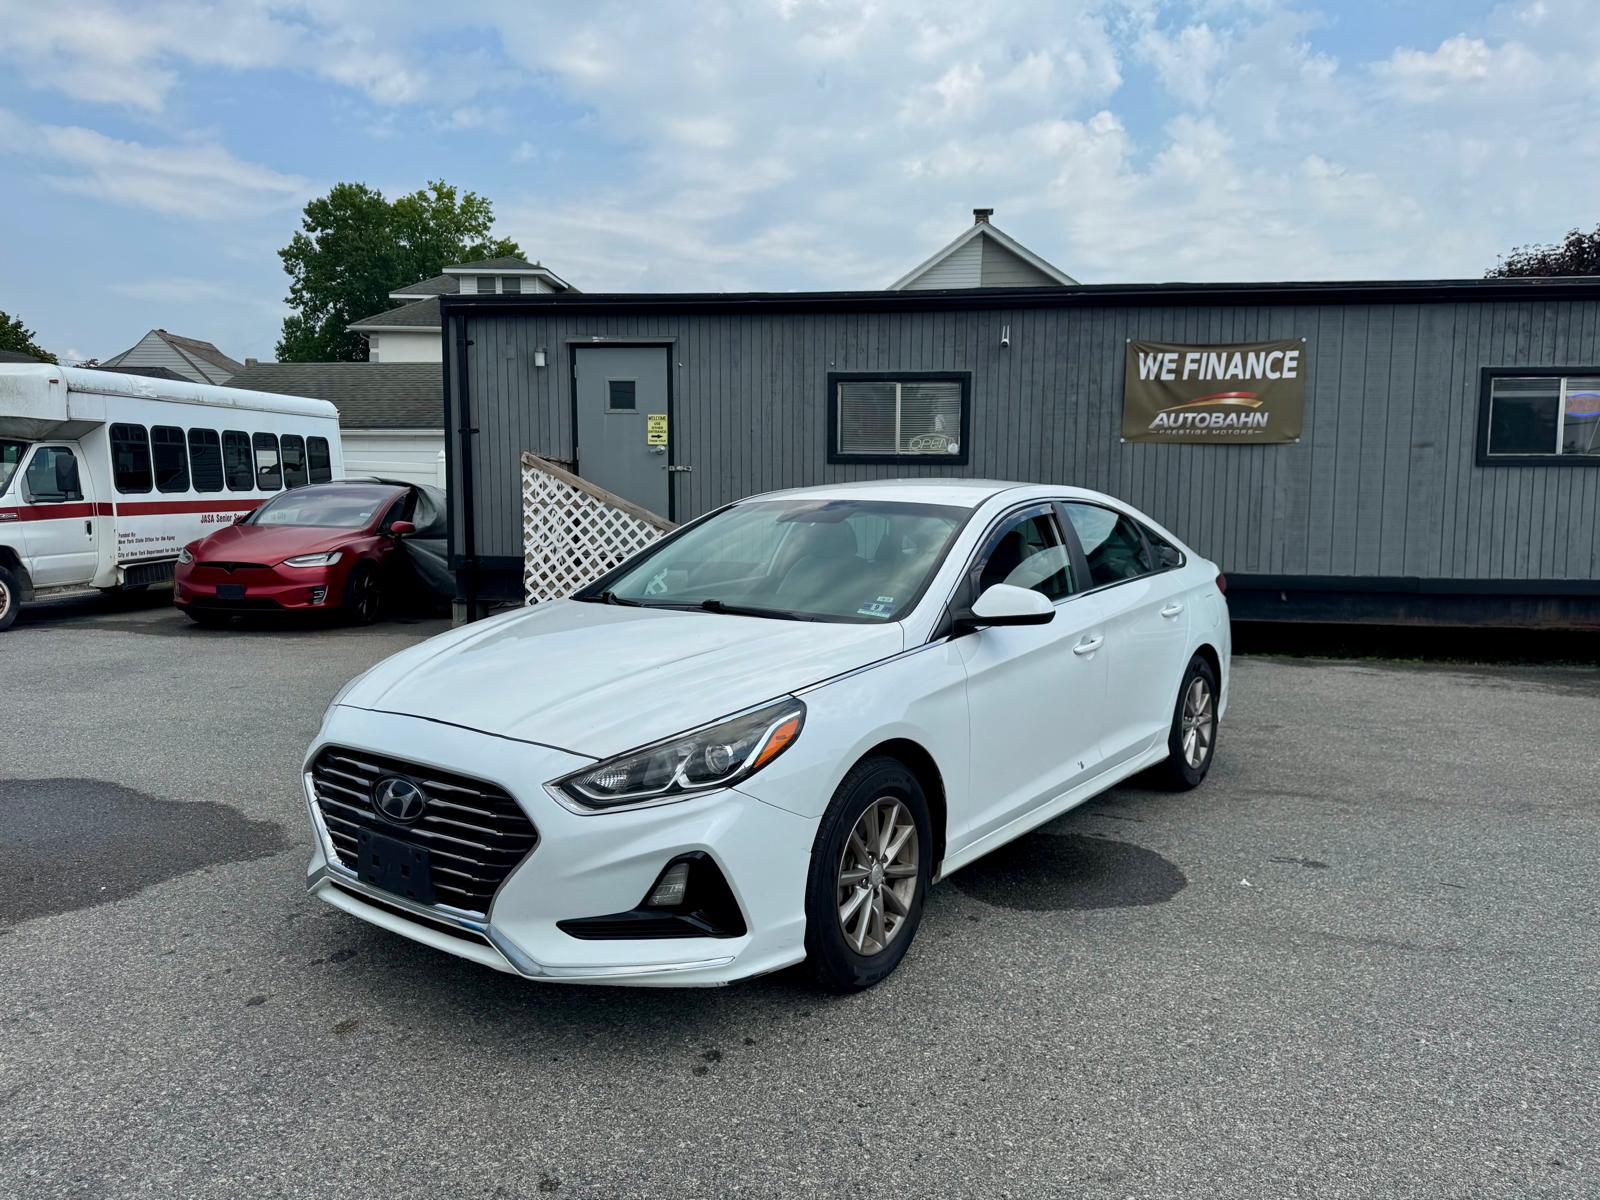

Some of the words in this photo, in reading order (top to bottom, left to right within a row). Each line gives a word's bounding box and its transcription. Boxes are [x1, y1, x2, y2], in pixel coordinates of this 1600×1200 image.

[1138, 352, 1178, 381] WE
[1182, 350, 1299, 381] FINANCE
[1148, 412, 1269, 429] AUTOBAHN
[200, 514, 214, 524] JASA
[216, 513, 232, 523] Senior
